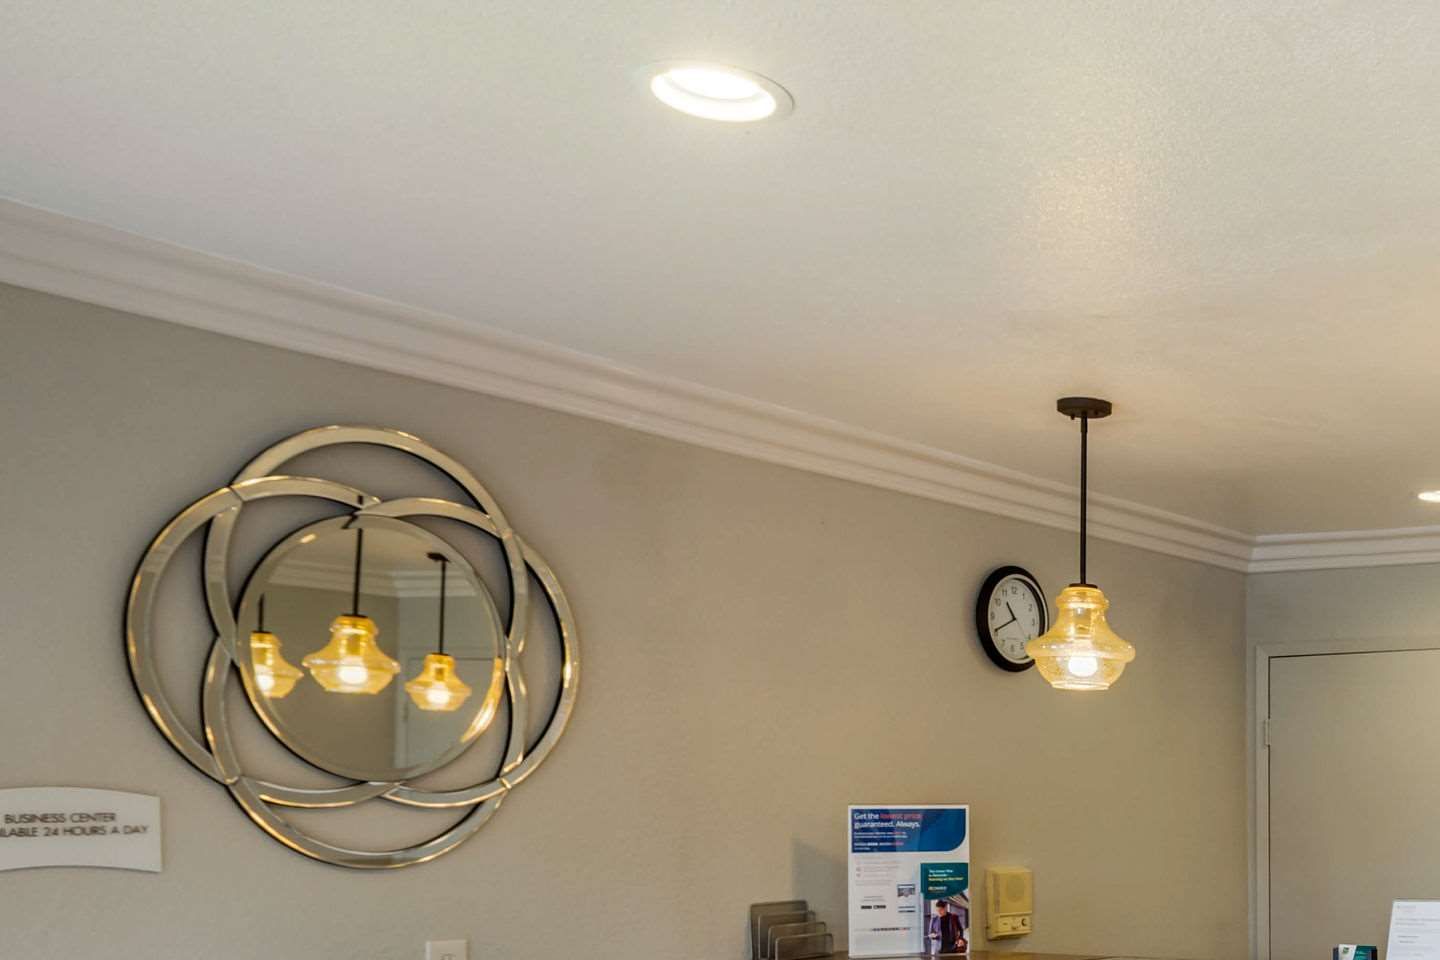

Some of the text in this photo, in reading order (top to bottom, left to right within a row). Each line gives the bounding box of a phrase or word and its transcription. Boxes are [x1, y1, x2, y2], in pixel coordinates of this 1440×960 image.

[4, 812, 117, 824] BUSINESS CENTER
[43, 826, 59, 837] 24
[63, 825, 106, 836] HOURS
[110, 826, 120, 834] A
[123, 824, 149, 835] DAY
